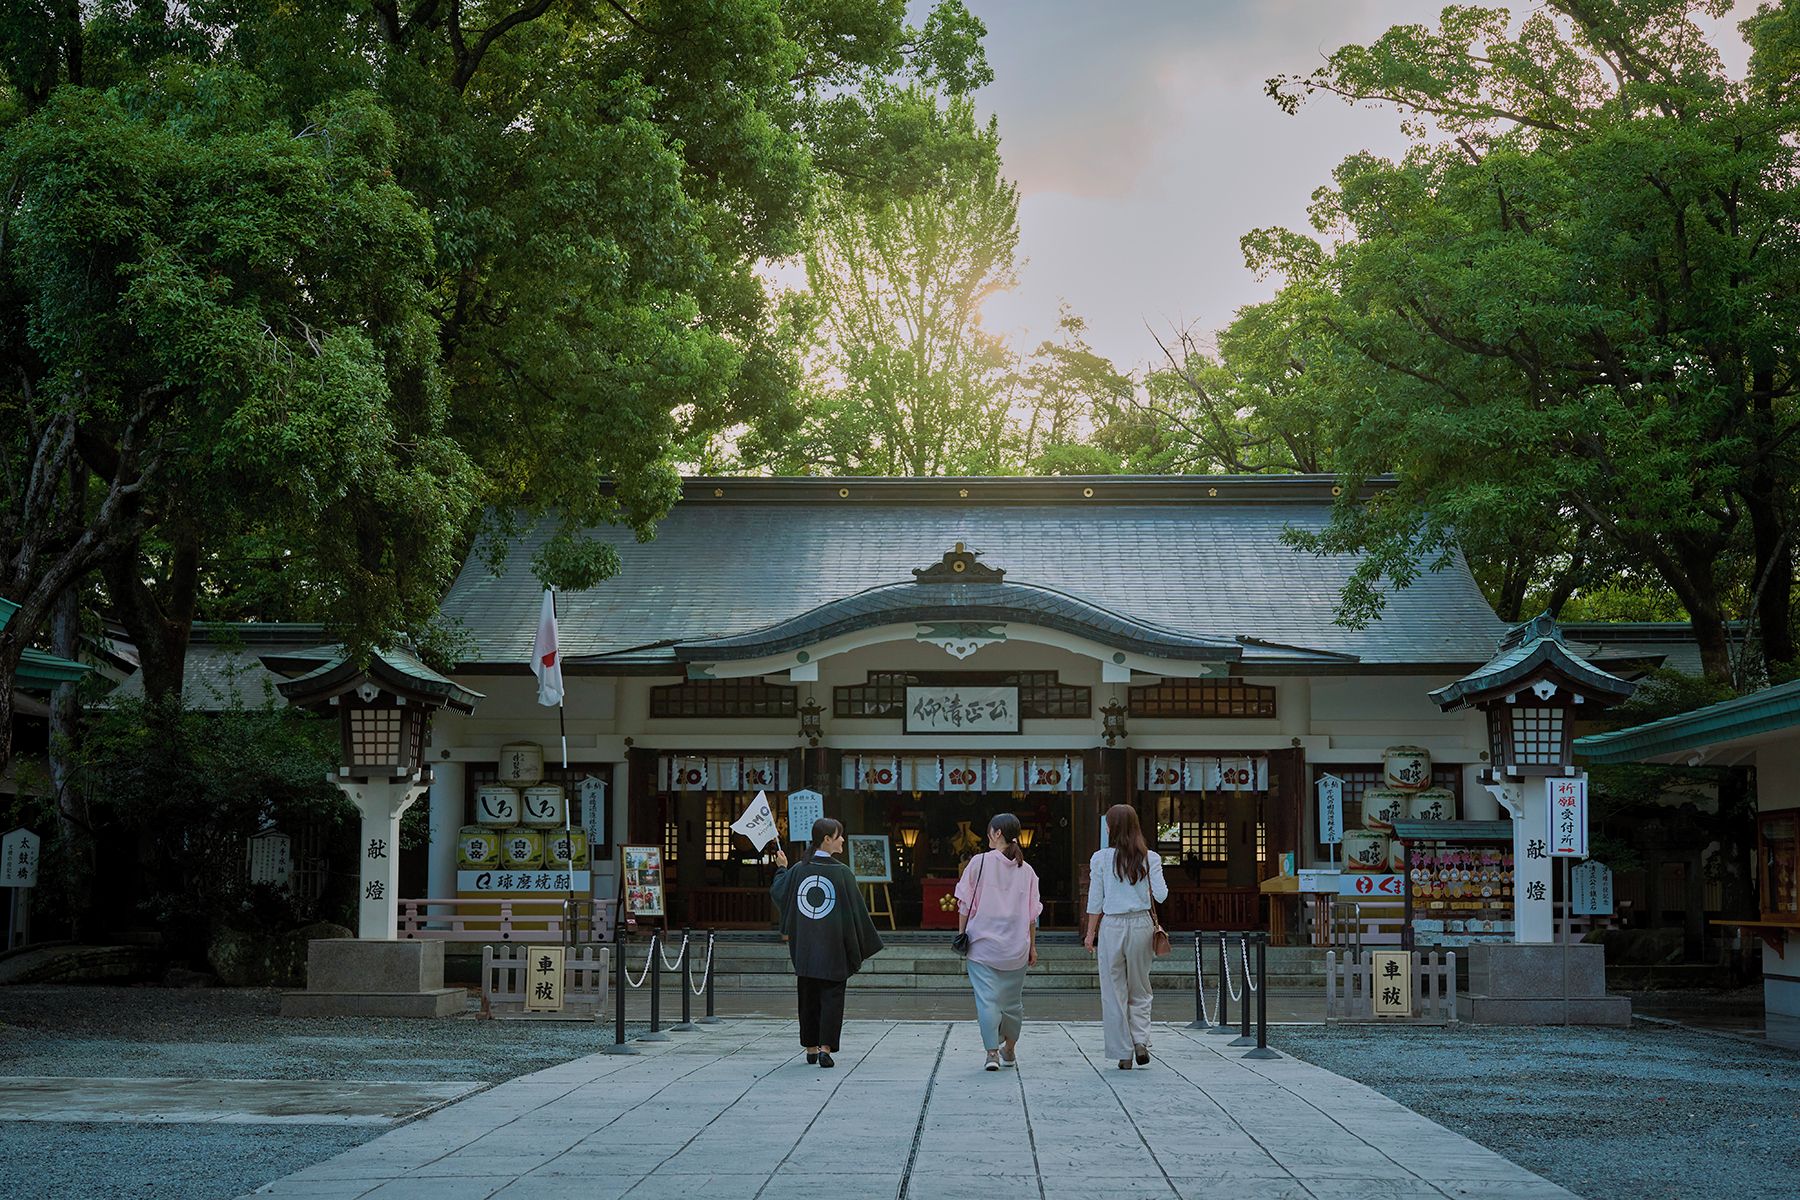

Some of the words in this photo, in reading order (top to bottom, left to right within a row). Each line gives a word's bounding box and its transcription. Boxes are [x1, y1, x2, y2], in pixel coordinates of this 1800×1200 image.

[481, 796, 513, 818] しろ
[524, 796, 555, 818] しろ
[746, 805, 770, 828] OMO
[1558, 783, 1576, 846] 祈願受付所
[17, 837, 30, 879] 太鼓橋
[469, 840, 483, 859] 白岳
[513, 840, 527, 859] 白岳
[365, 839, 387, 900] 献燈
[497, 873, 570, 890] 球磨焼酎
[1526, 839, 1547, 901] 献燈
[535, 955, 555, 1000] 車祓
[1382, 960, 1402, 1006] 車祓
